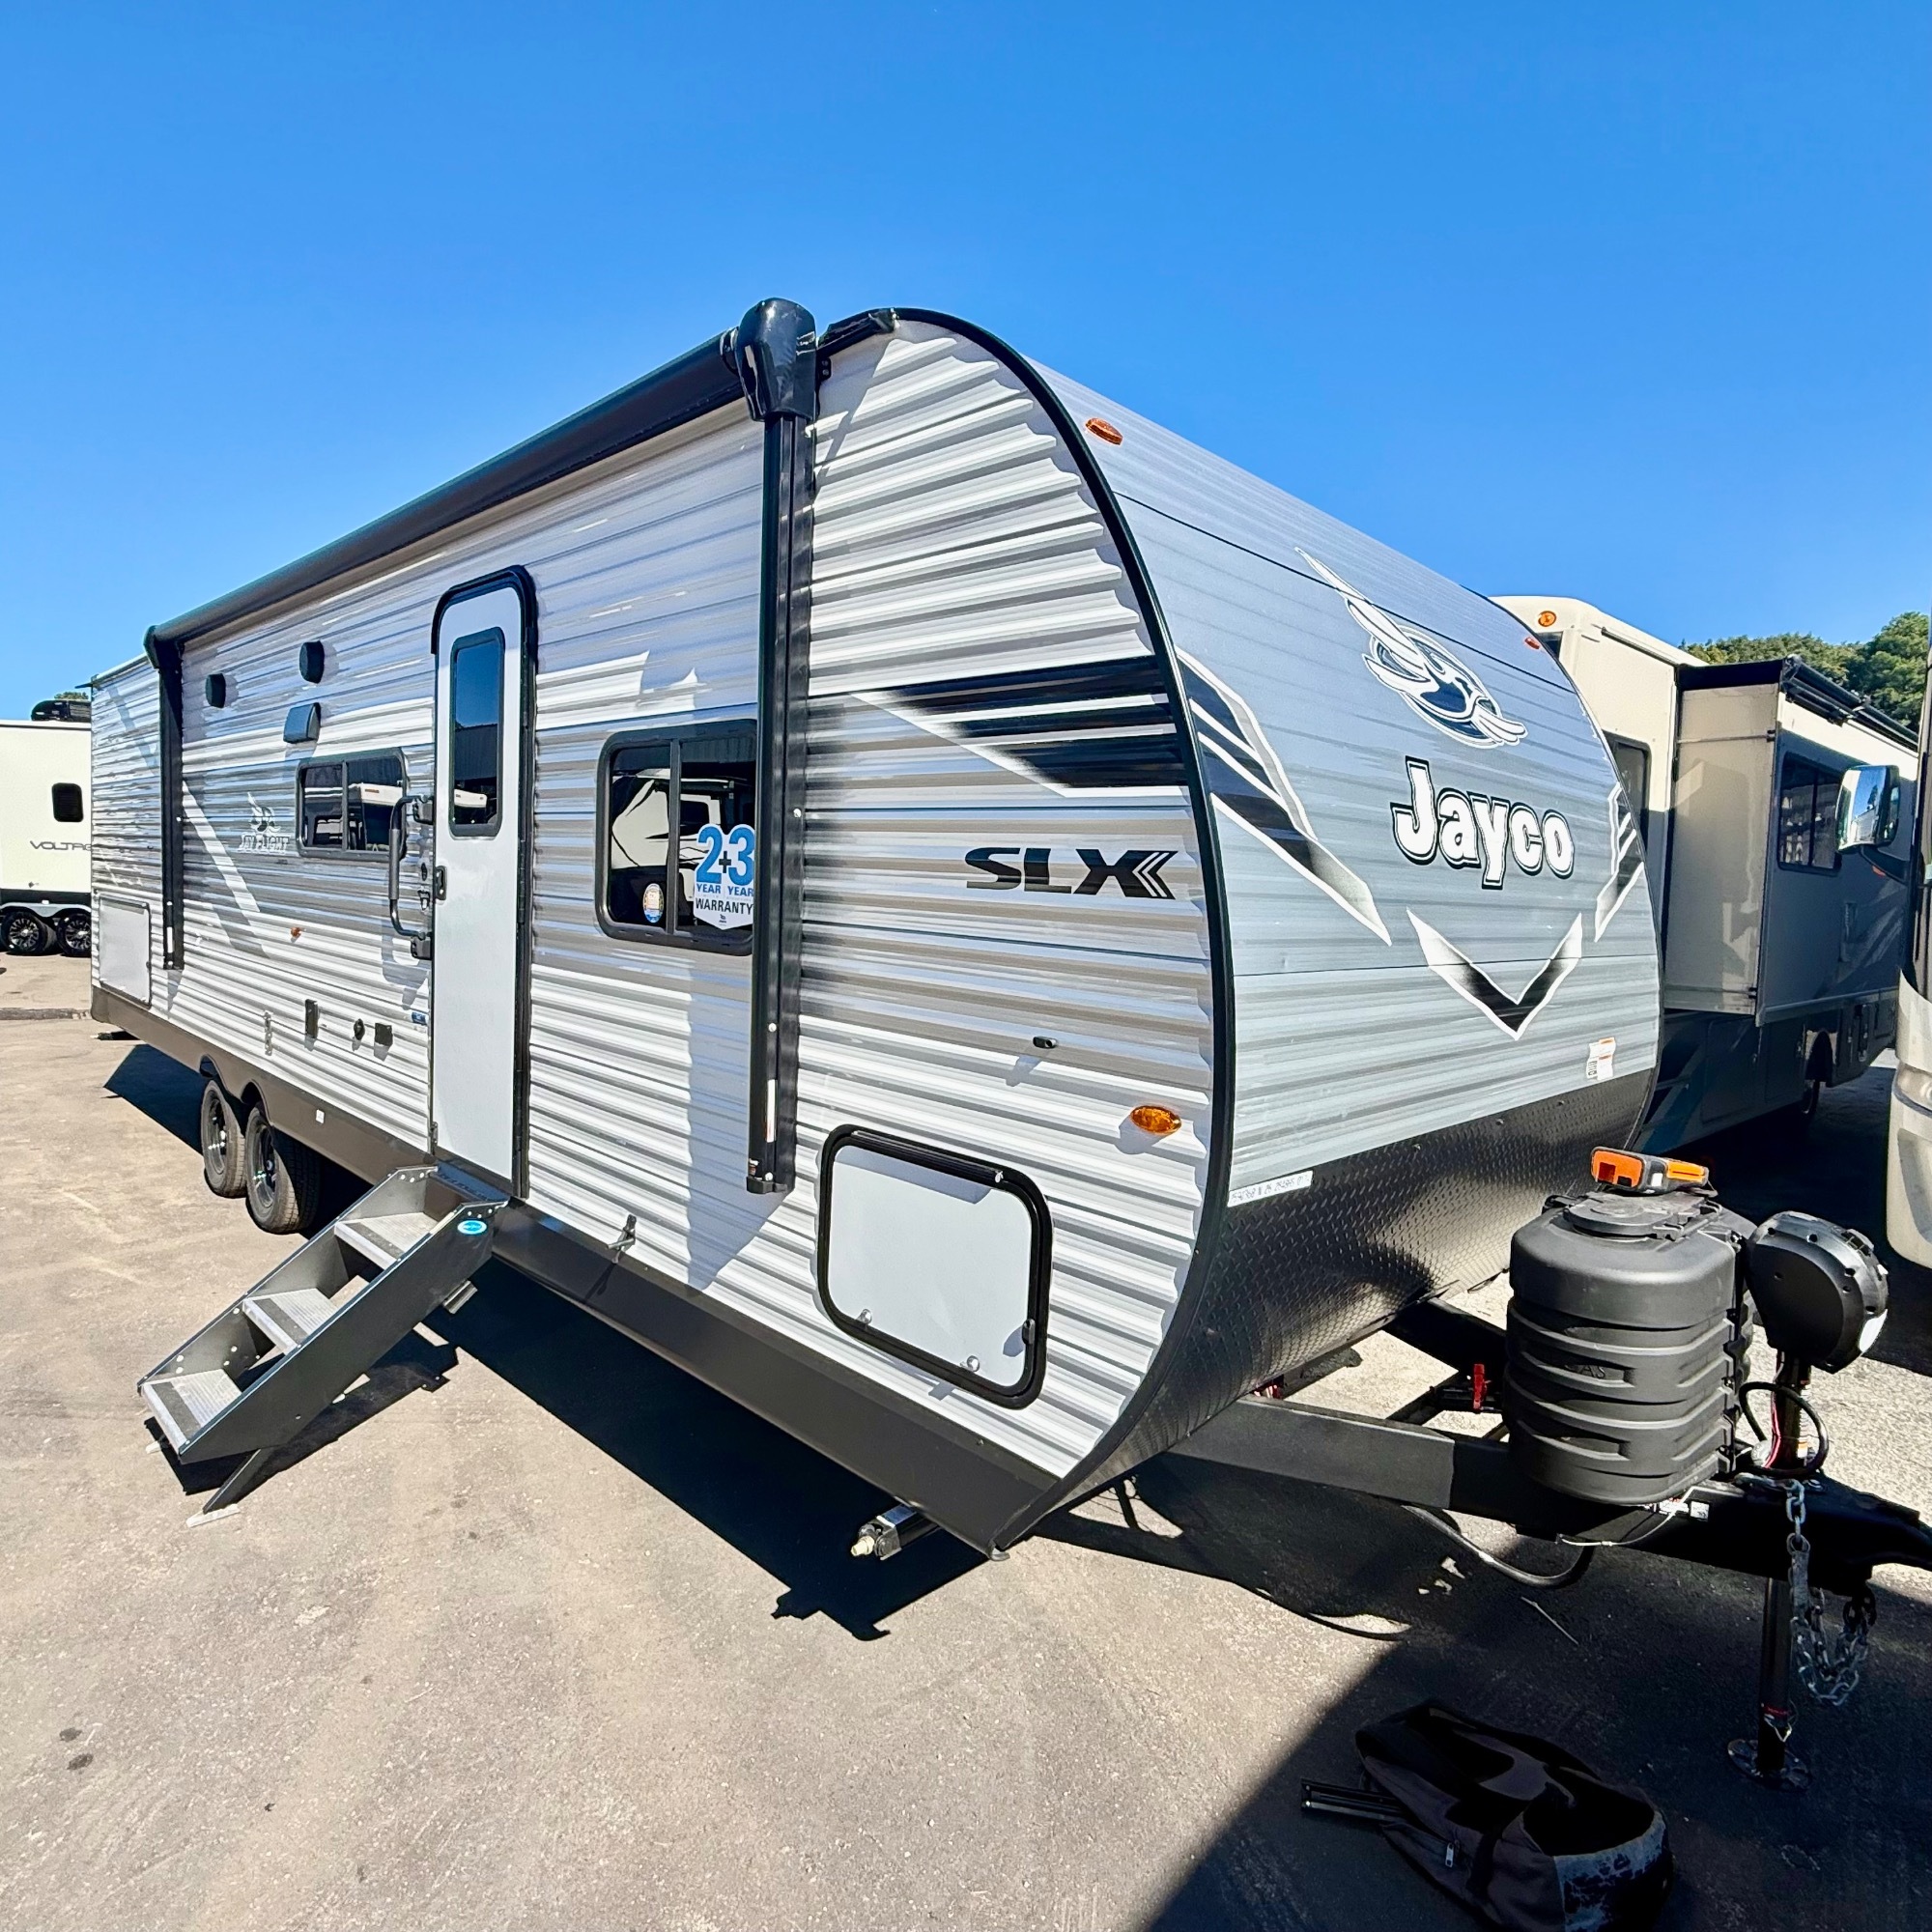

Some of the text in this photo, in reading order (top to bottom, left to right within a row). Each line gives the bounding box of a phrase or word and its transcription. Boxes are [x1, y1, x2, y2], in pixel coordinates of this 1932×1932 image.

[1390, 755, 1575, 890] Jayco
[256, 835, 290, 854] FLIGHT
[965, 847, 1179, 899] SLX
[696, 883, 722, 895] YEAR
[727, 885, 753, 897] YEAR
[696, 897, 753, 915] WARRANTY
